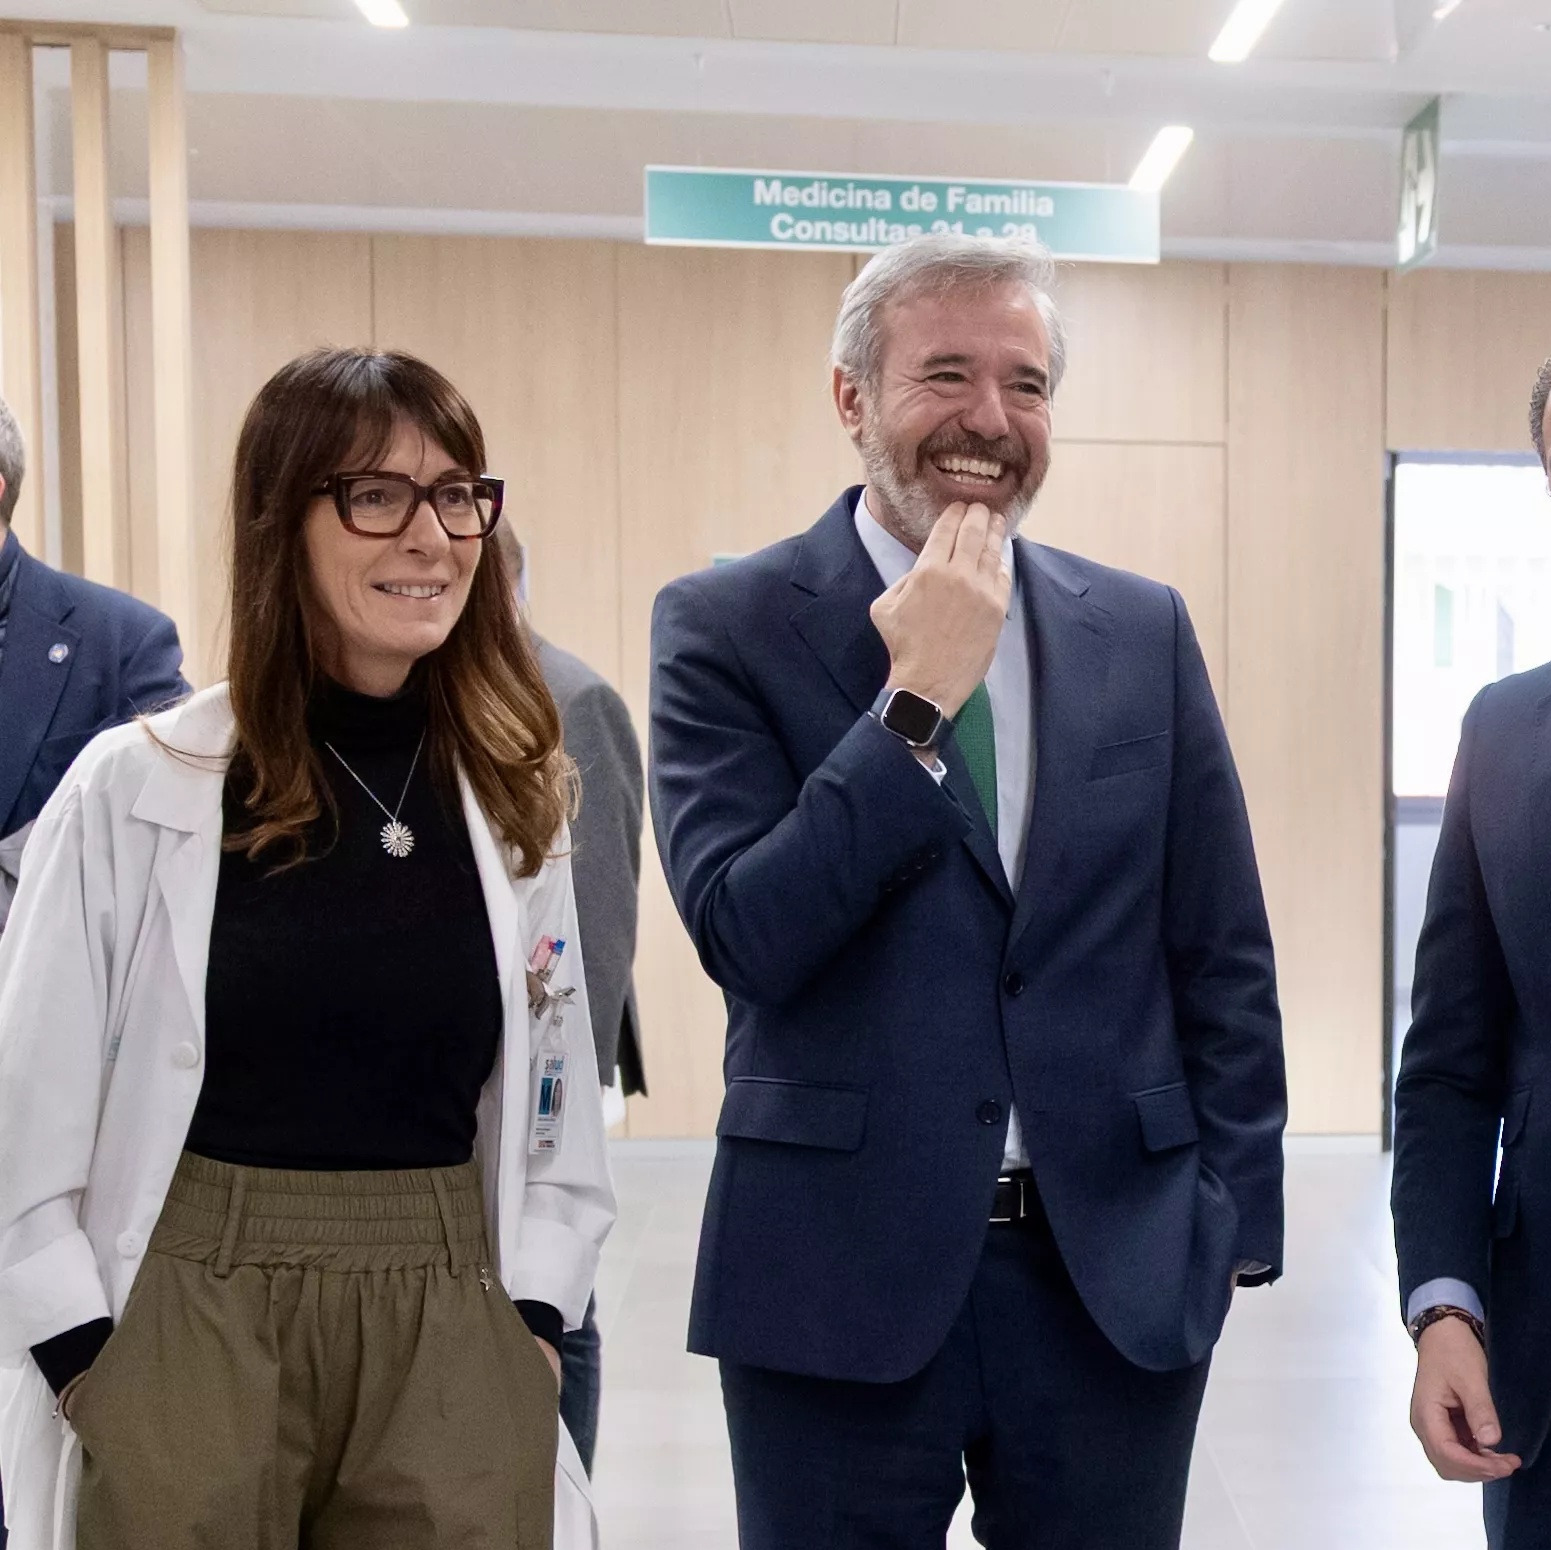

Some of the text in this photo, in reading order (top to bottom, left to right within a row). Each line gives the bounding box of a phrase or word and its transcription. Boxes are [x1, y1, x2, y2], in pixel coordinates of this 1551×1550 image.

[754, 178, 1054, 218] Medicina de Familia
[769, 212, 923, 243] Consultas
